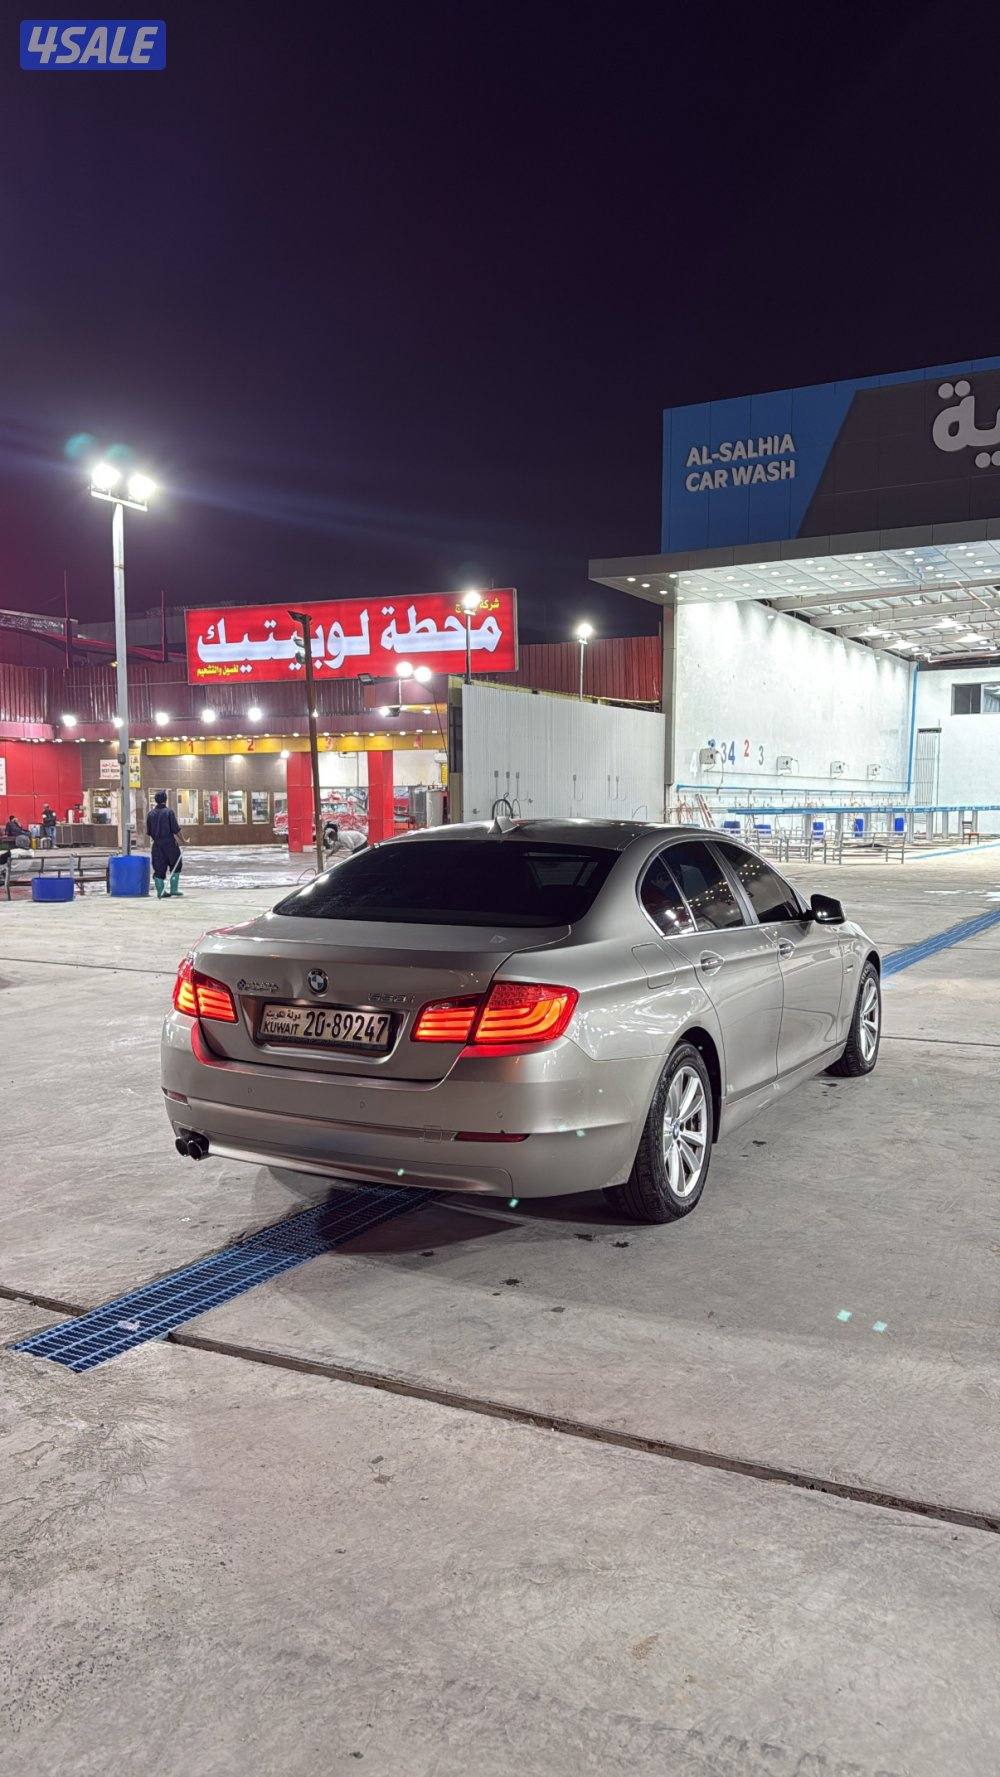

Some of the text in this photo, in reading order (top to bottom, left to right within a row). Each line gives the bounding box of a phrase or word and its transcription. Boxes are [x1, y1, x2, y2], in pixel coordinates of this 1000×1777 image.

[686, 433, 796, 467] AL-SALHIA
[685, 459, 796, 492] CAR WASH
[380, 604, 503, 654] محطة
[246, 738, 255, 752] 2
[744, 739, 750, 757] 2
[758, 745, 765, 766] 3
[263, 1020, 300, 1035] KUWAIT
